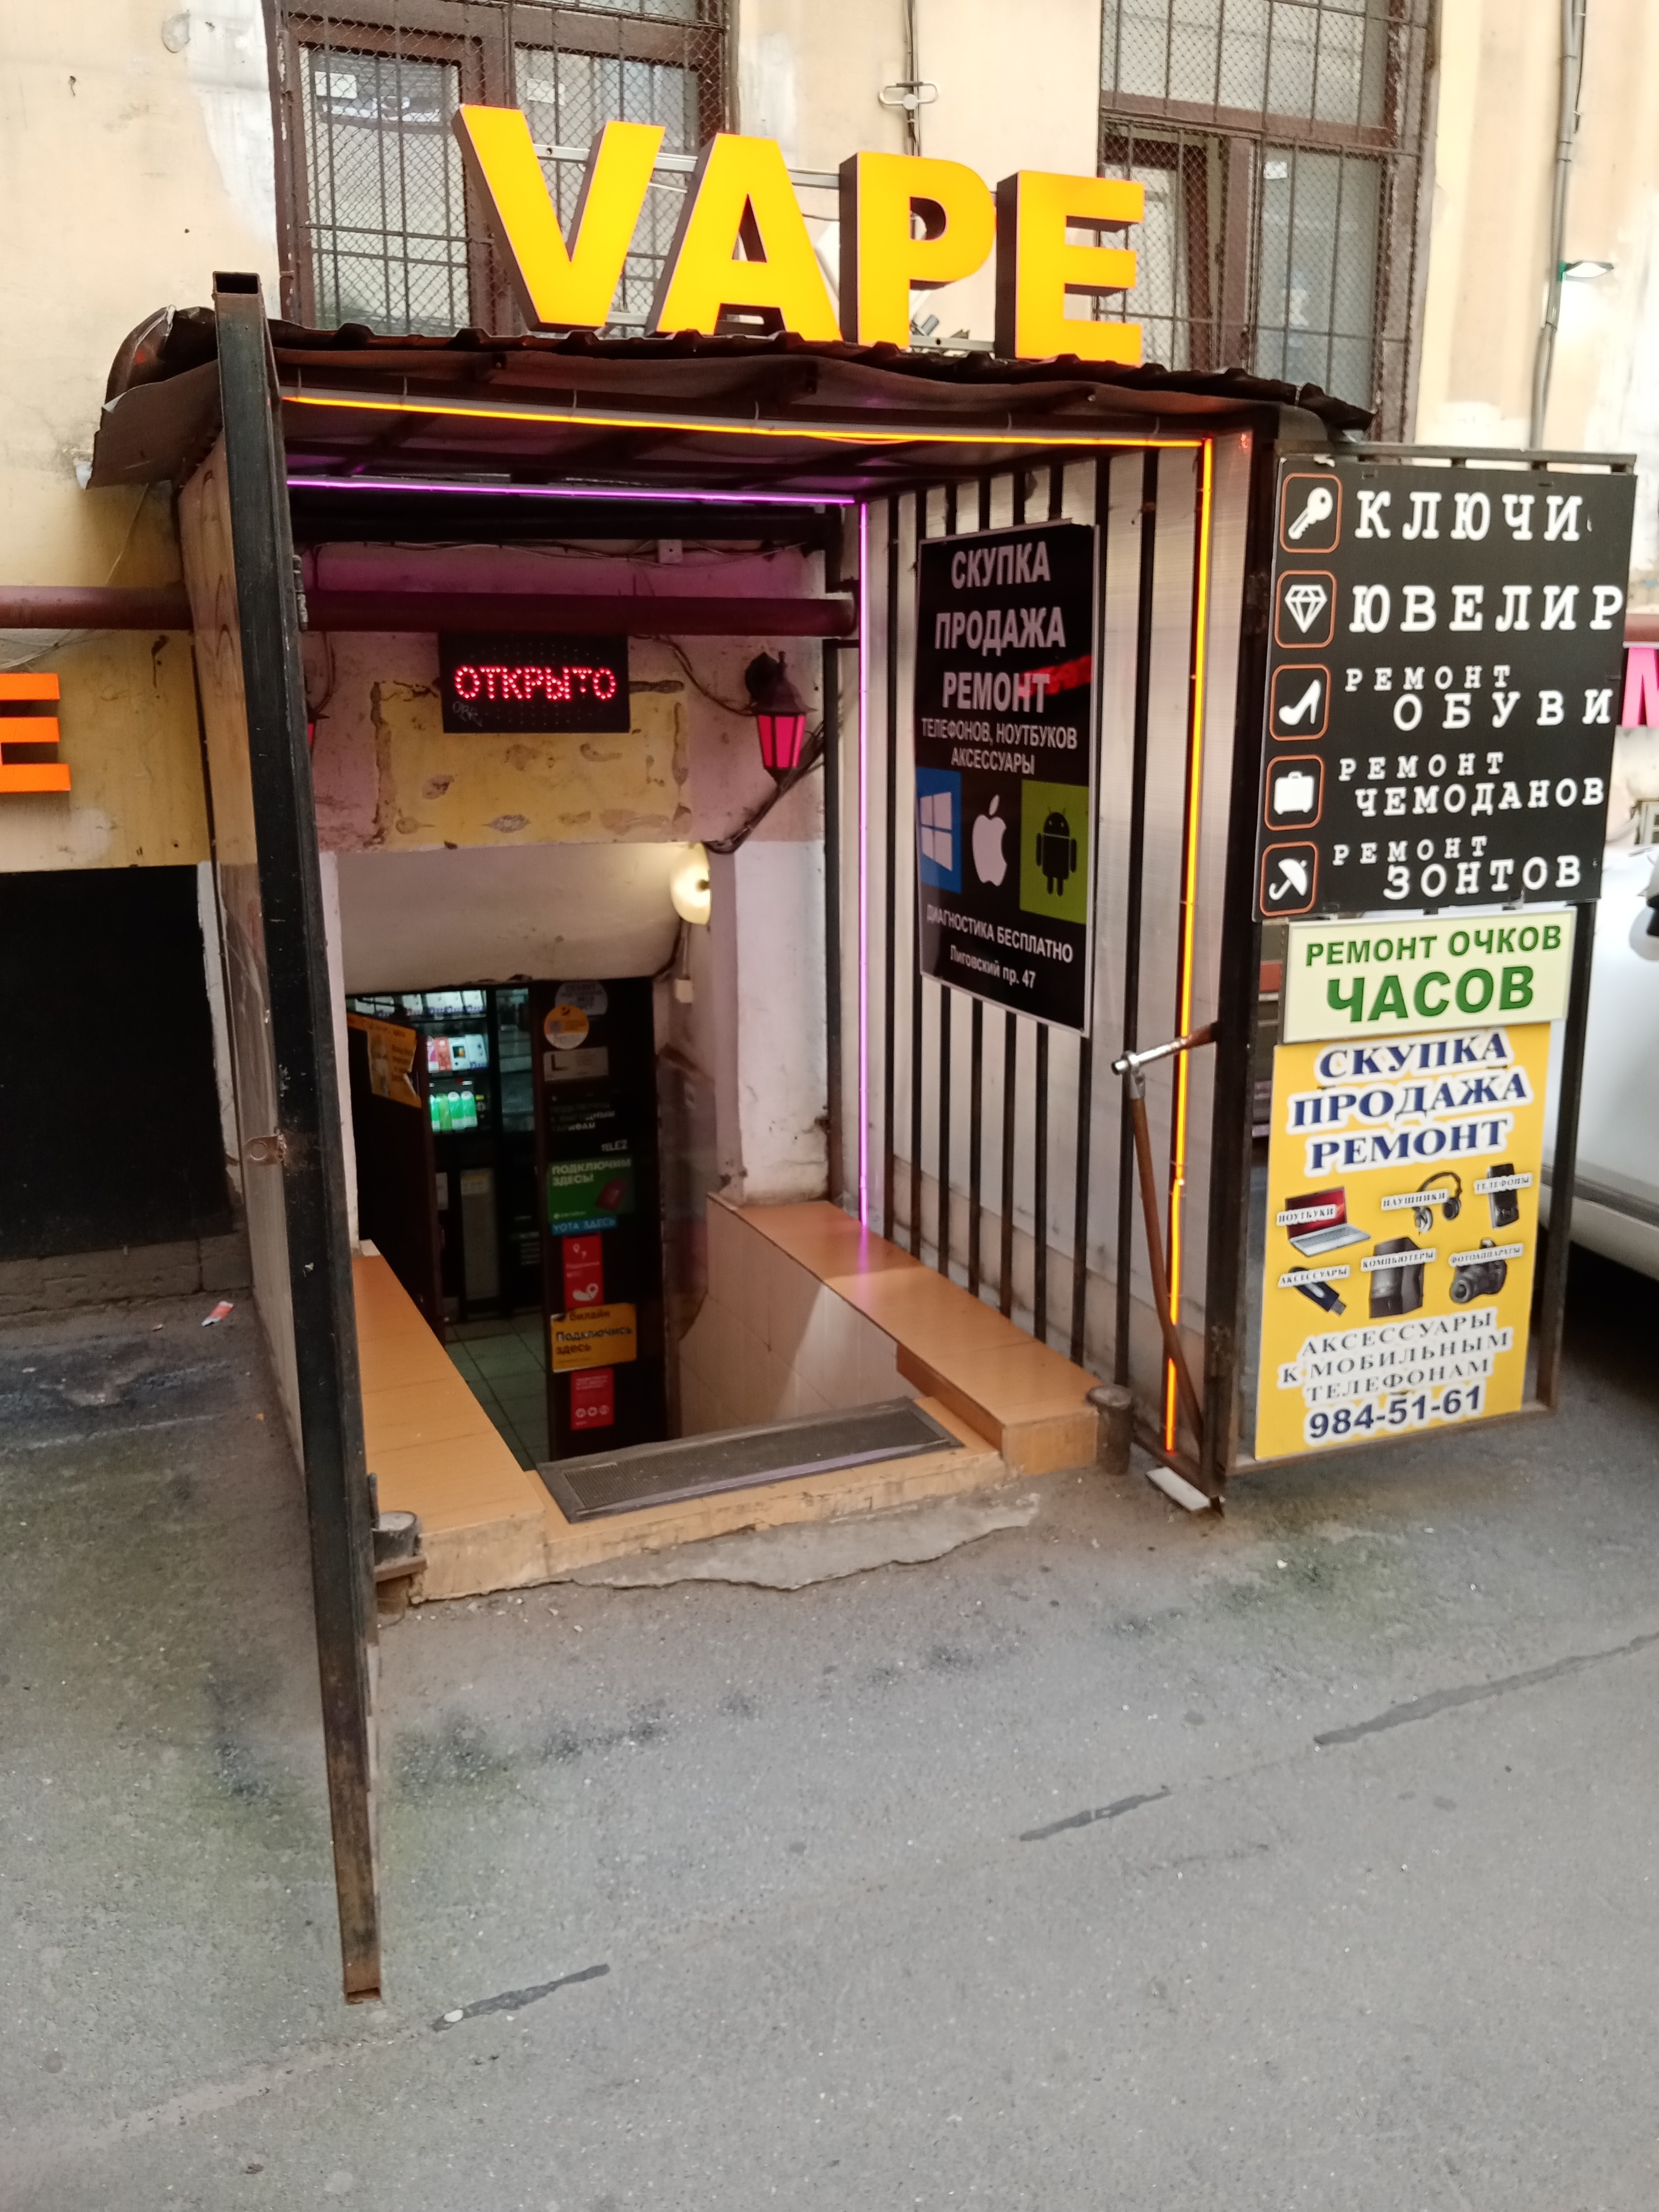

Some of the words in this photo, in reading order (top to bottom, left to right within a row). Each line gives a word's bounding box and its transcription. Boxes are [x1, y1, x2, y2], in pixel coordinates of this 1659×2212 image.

[455, 103, 1144, 367] VAPE
[1354, 490, 1583, 541] КЛЮЧИ
[951, 541, 1050, 589] СКУПКА
[1349, 583, 1623, 633] ЮВЕЛИР
[935, 606, 1066, 657] ПРОДАЖА
[455, 666, 617, 701] ОТКРЫТО
[942, 672, 1050, 713] РЕМОНТ
[1345, 665, 1511, 691] РЕМОНТ
[1393, 689, 1613, 731] ОБУВИ
[921, 718, 993, 745] ТЕЛЕФОНОВ,
[996, 723, 1077, 749] НОУТБУКОВ
[951, 747, 1035, 775] АКСЕССУАРЫ
[1338, 752, 1504, 781] РЕМОНТ
[1355, 777, 1605, 817] ЧЕМОДАНОВ
[1333, 836, 1487, 865] РЕМОНТ
[1383, 855, 1581, 899] ЗОНТОВ
[926, 904, 995, 942] ДИАГНОСТИКА
[997, 926, 1073, 963] БЕСПЛАТНО
[1306, 936, 1437, 966] РЕМОНТ
[1448, 925, 1561, 957] ОЧКОВ
[1002, 962, 1020, 985] пр.
[1022, 970, 1036, 988] 47
[1327, 966, 1534, 1023] ЧАСОВ
[1320, 1033, 1507, 1078] СКУПКА
[1294, 1073, 1527, 1127] ПРОДАЖА
[1311, 1119, 1508, 1170] РЕМОНТ
[1384, 1192, 1446, 1208] НАУШНИКИ
[1476, 1176, 1530, 1191] ТЕЛЕФОНЫ
[1278, 1207, 1334, 1224] НОУТБУКИ
[1363, 1251, 1434, 1268] КОМПЬЮТЕРЫ
[1452, 1247, 1521, 1264] ФОТОАППАРАТЫ
[1280, 1268, 1347, 1285] АКСЕССУАРЫ
[556, 1344, 591, 1356] здесь
[1302, 1312, 1492, 1356] АКСЕССУАРЫ
[1283, 1367, 1298, 1384] К
[1310, 1332, 1508, 1379] МОБИЛЬНЫМ
[1306, 1359, 1488, 1402] ТЕЛЕФОНАМ
[1310, 1386, 1480, 1438] 984-51-61
